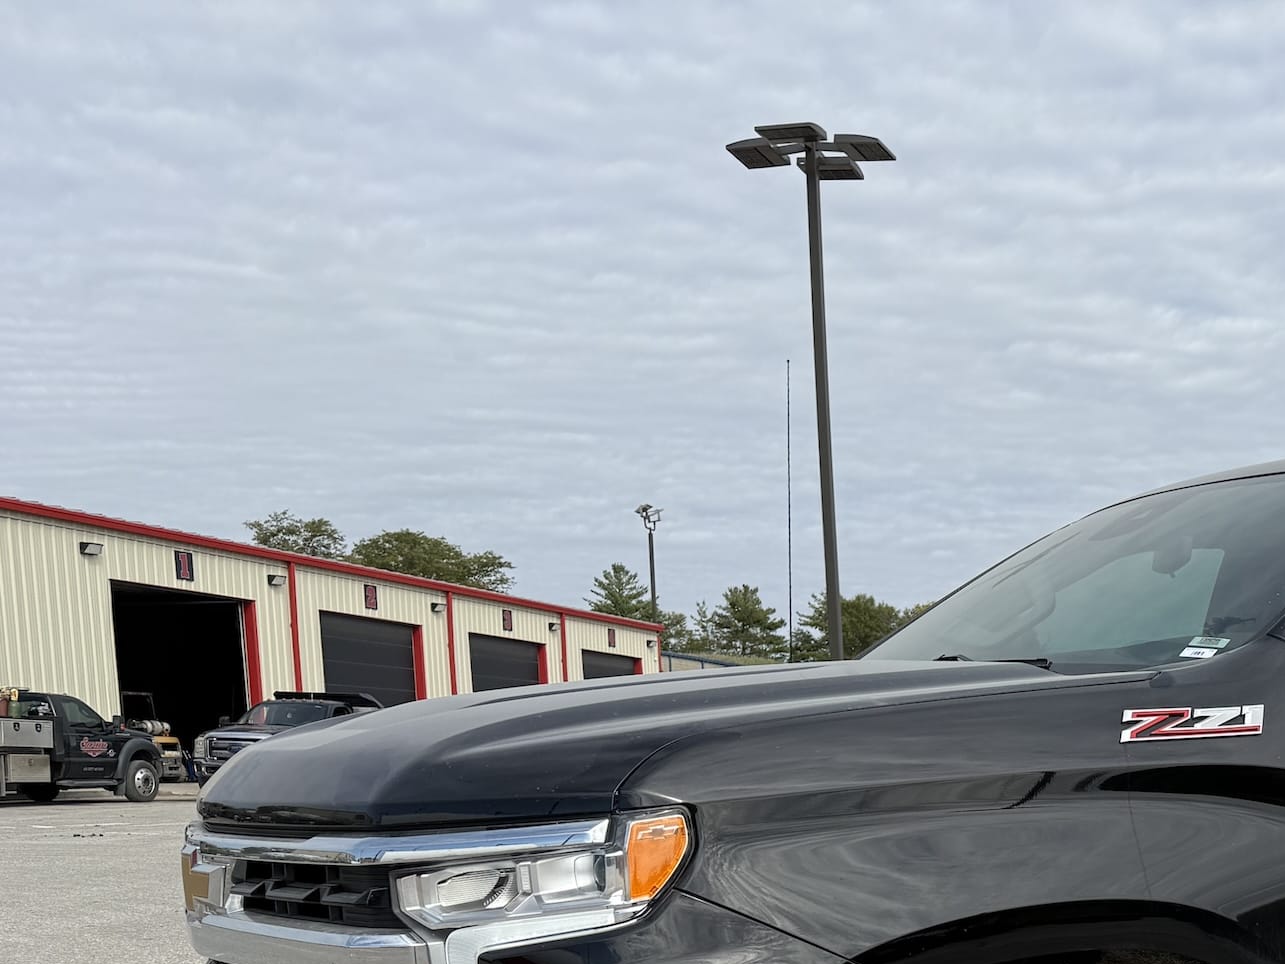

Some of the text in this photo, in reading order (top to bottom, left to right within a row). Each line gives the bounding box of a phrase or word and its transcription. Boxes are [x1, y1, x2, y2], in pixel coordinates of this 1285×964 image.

[178, 552, 190, 579] 1
[366, 586, 376, 608] 2
[1120, 704, 1265, 743] Z71
